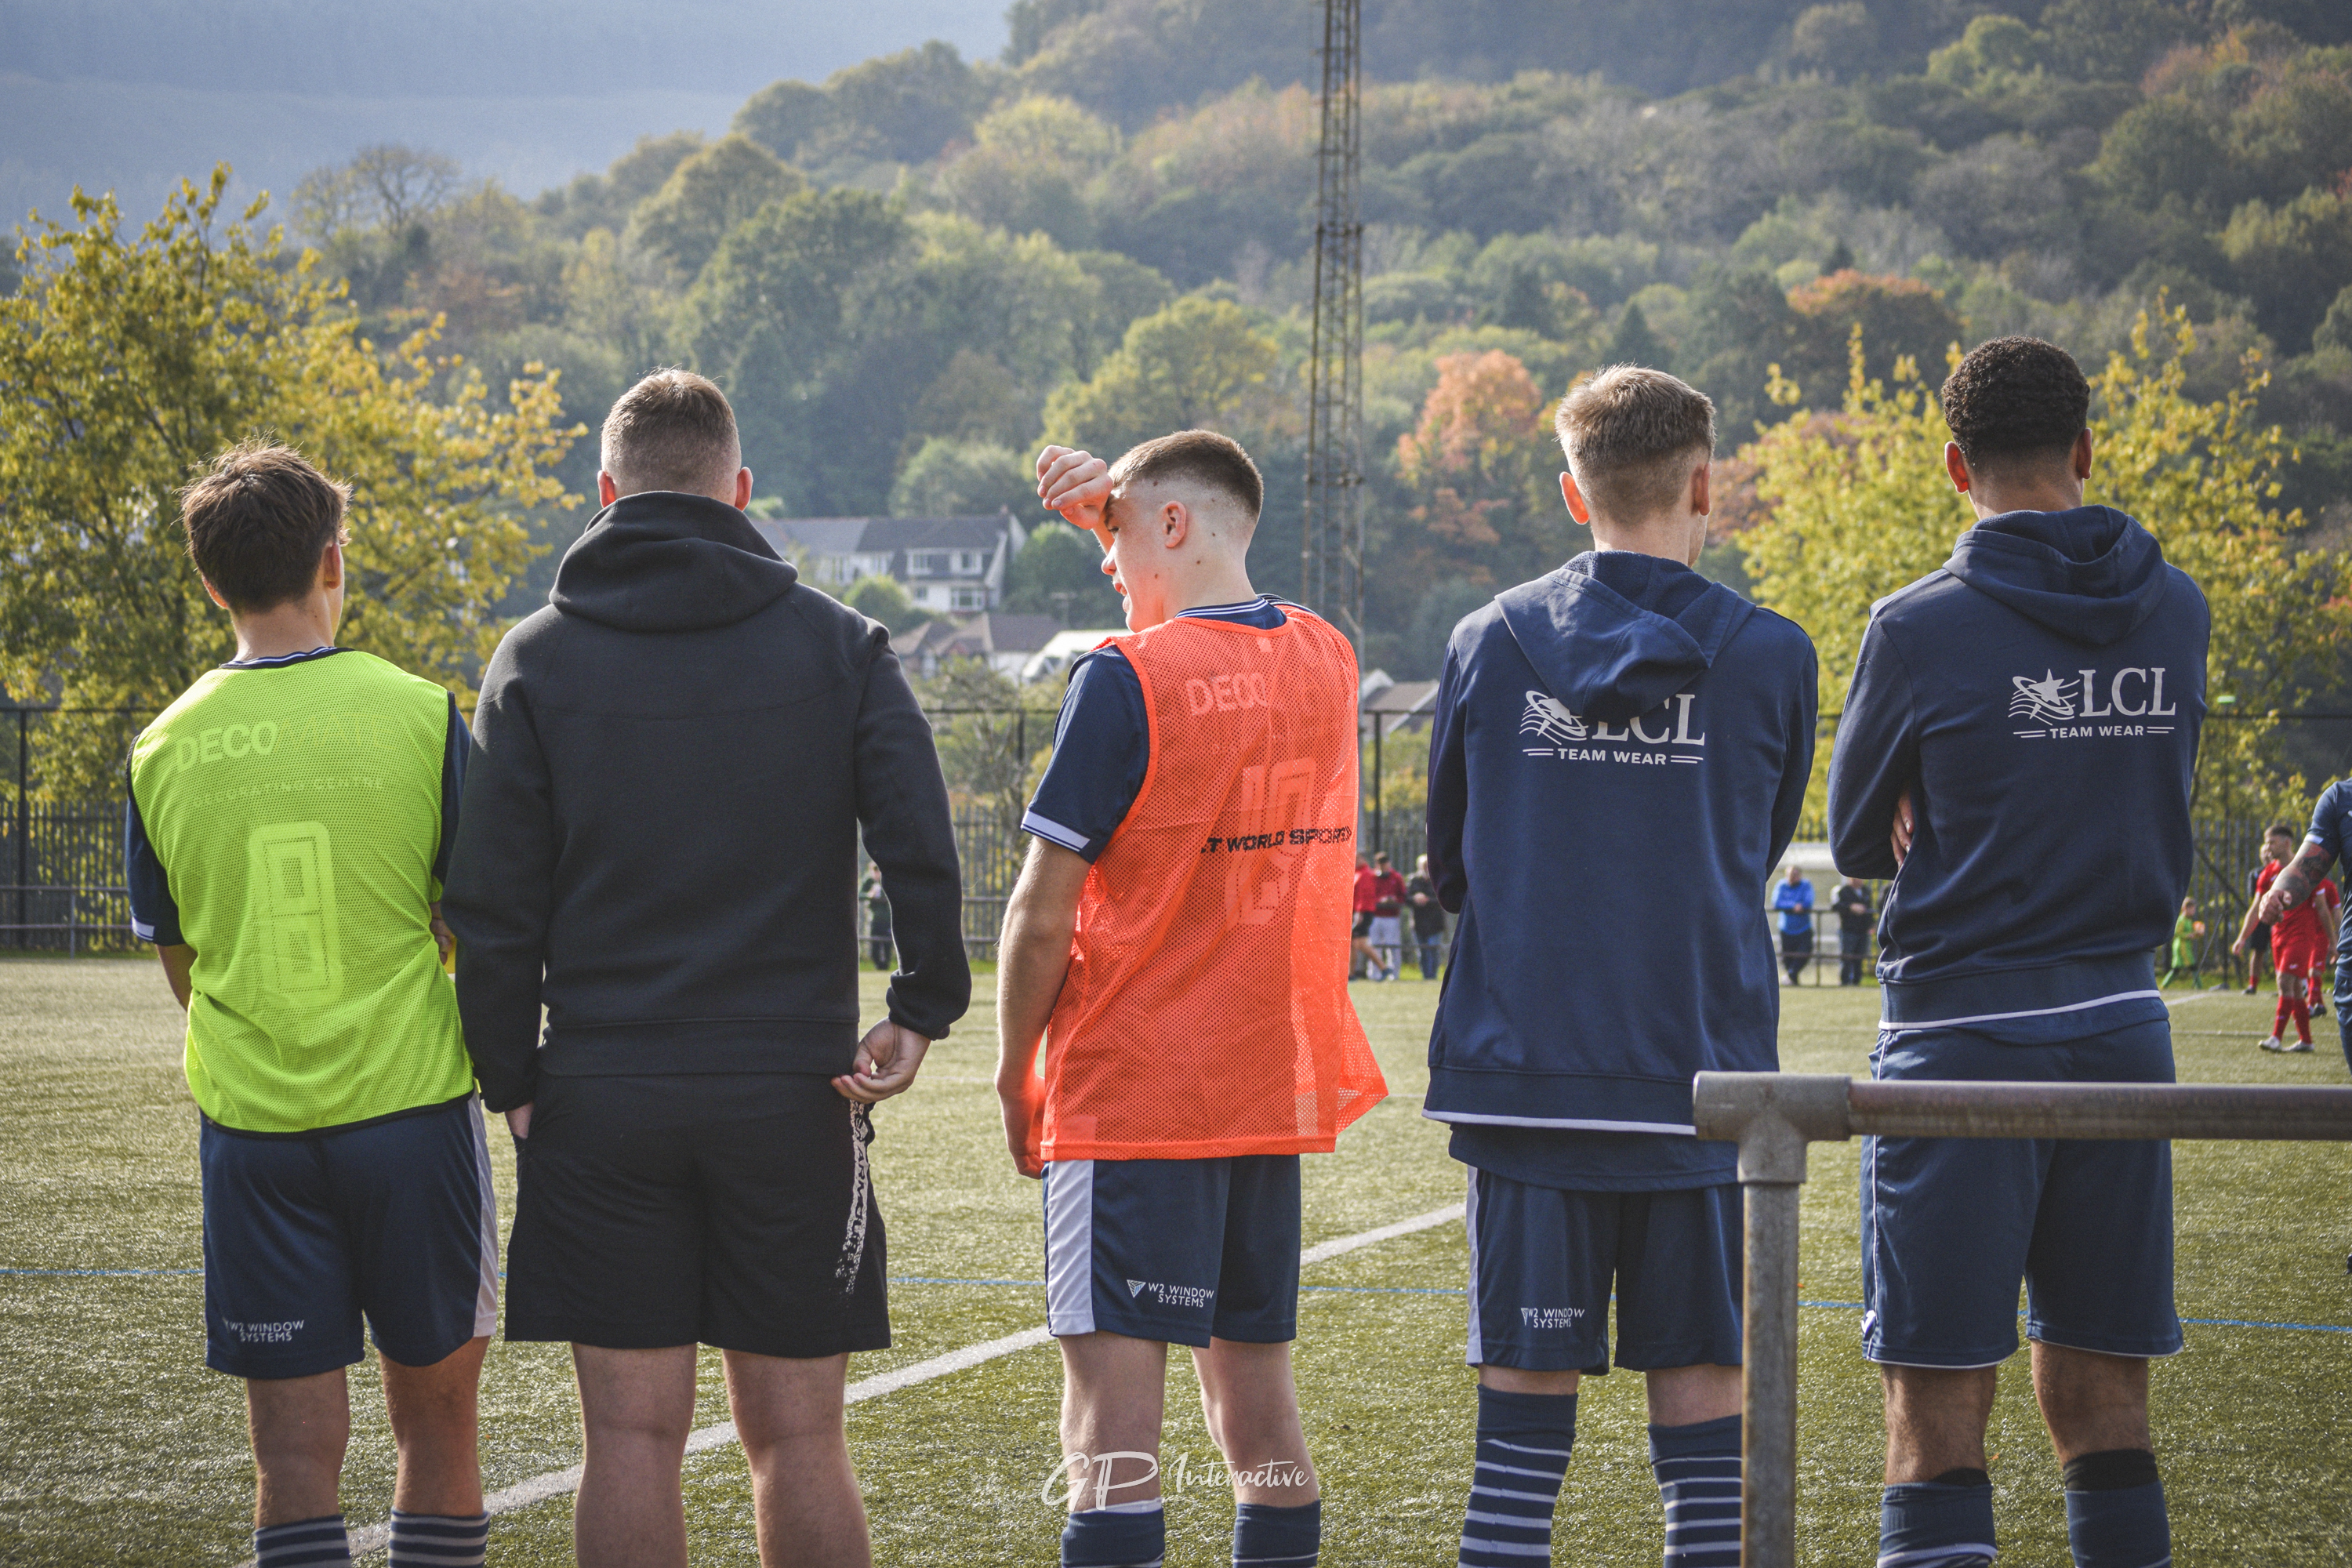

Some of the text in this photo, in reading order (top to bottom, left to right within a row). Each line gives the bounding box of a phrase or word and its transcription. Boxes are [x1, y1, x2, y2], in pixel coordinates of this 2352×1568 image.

[2078, 667, 2176, 717] LCL
[2049, 725, 2144, 739] TEAM WEAR
[1558, 748, 1667, 764] TEAM WEAR
[1227, 830, 1285, 852] WORLD
[1148, 1282, 1214, 1299] W2 WINDOW
[1158, 1294, 1204, 1308] SYSTEMS
[1528, 1308, 1585, 1318] W2 WINDOW
[230, 1319, 305, 1333] W2 WINDOW
[1534, 1318, 1572, 1328] SYSTEMS
[240, 1331, 293, 1342] SYSTEMS
